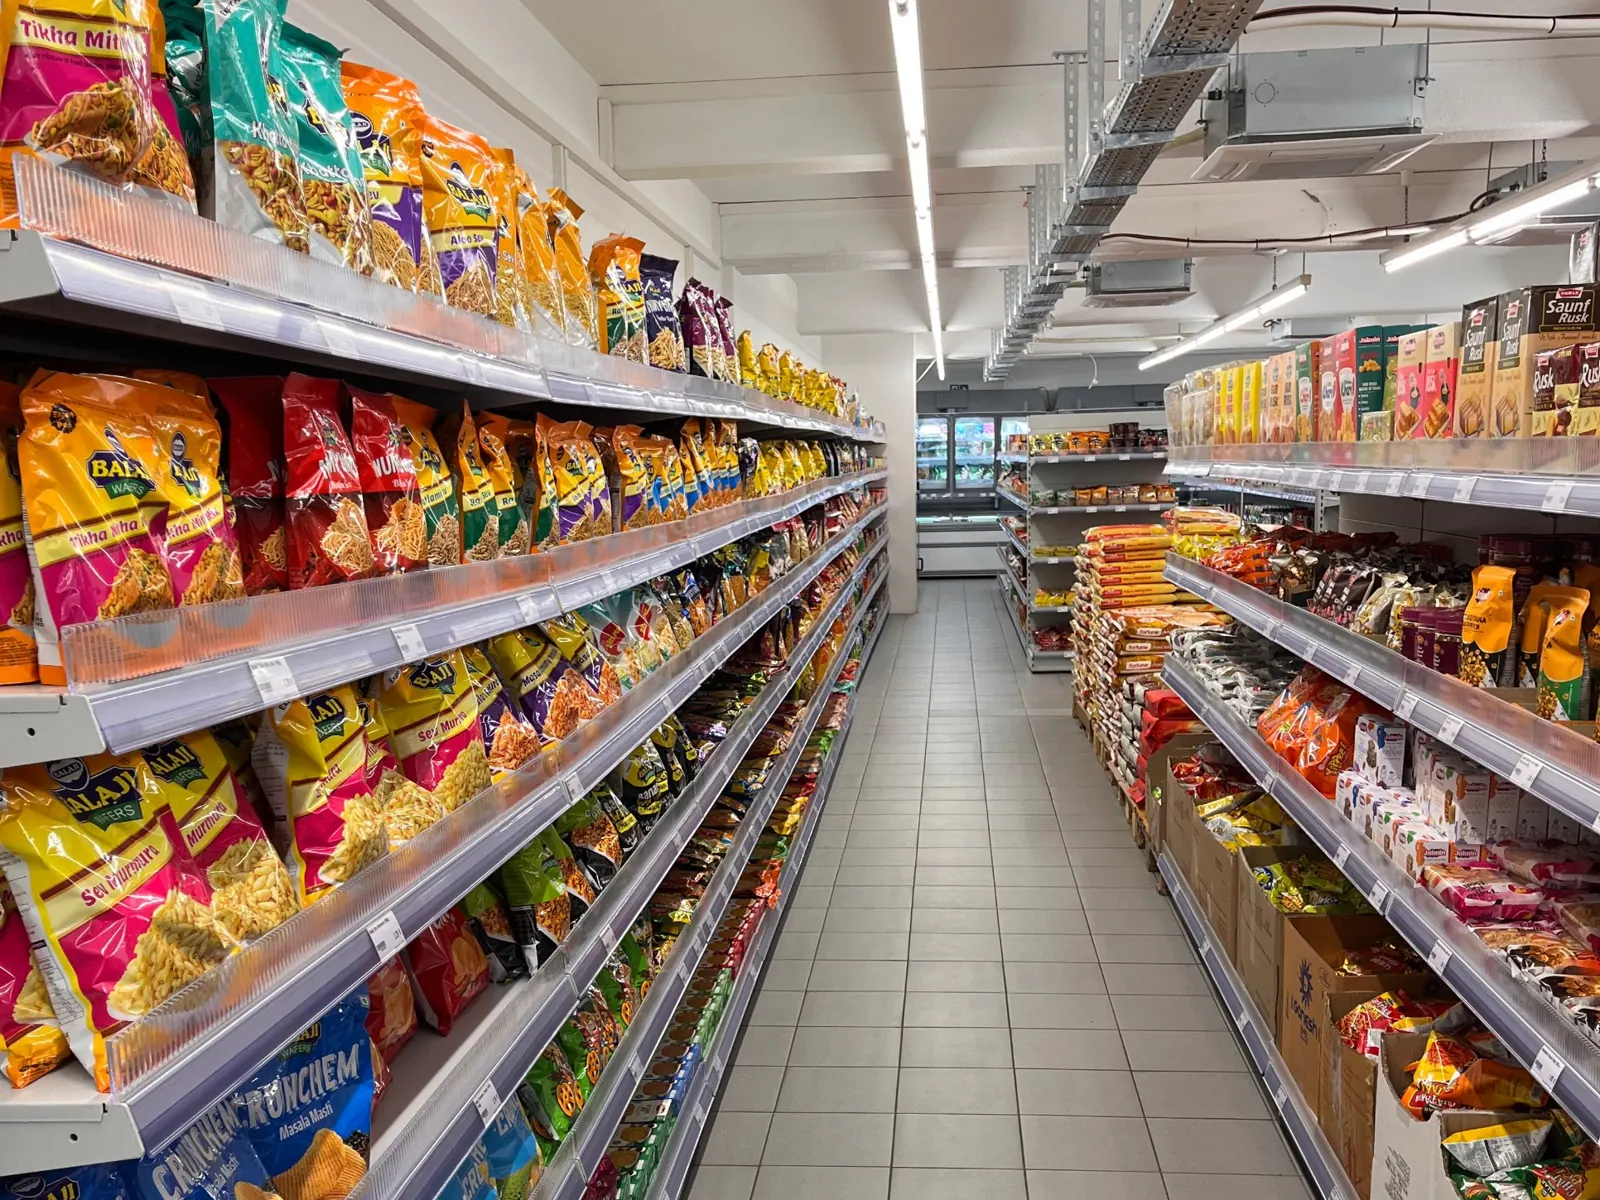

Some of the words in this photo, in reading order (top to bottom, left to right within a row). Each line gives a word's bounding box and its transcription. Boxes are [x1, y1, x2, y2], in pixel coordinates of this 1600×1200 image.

[20, 19, 78, 46] Tikha
[1546, 299, 1591, 314] Saunf
[1558, 313, 1589, 324] Rusk
[1465, 326, 1487, 348] Saunf
[1502, 318, 1522, 342] Saunf
[1469, 345, 1484, 361] Rusk
[1505, 339, 1519, 356] Rusk
[1533, 367, 1554, 393] Rusk
[1580, 363, 1600, 388] Rus
[91, 459, 149, 478] BALA
[0, 528, 24, 547] kha
[312, 698, 343, 723] LAJI
[417, 727, 439, 743] Sev
[149, 745, 196, 775] ALAJI
[65, 771, 138, 815] ALAJI
[81, 882, 109, 907] Sev
[280, 1044, 311, 1059] WAFERS
[279, 1117, 311, 1141] Masala
[310, 1100, 334, 1124] Masti
[220, 1153, 240, 1184] Masti
